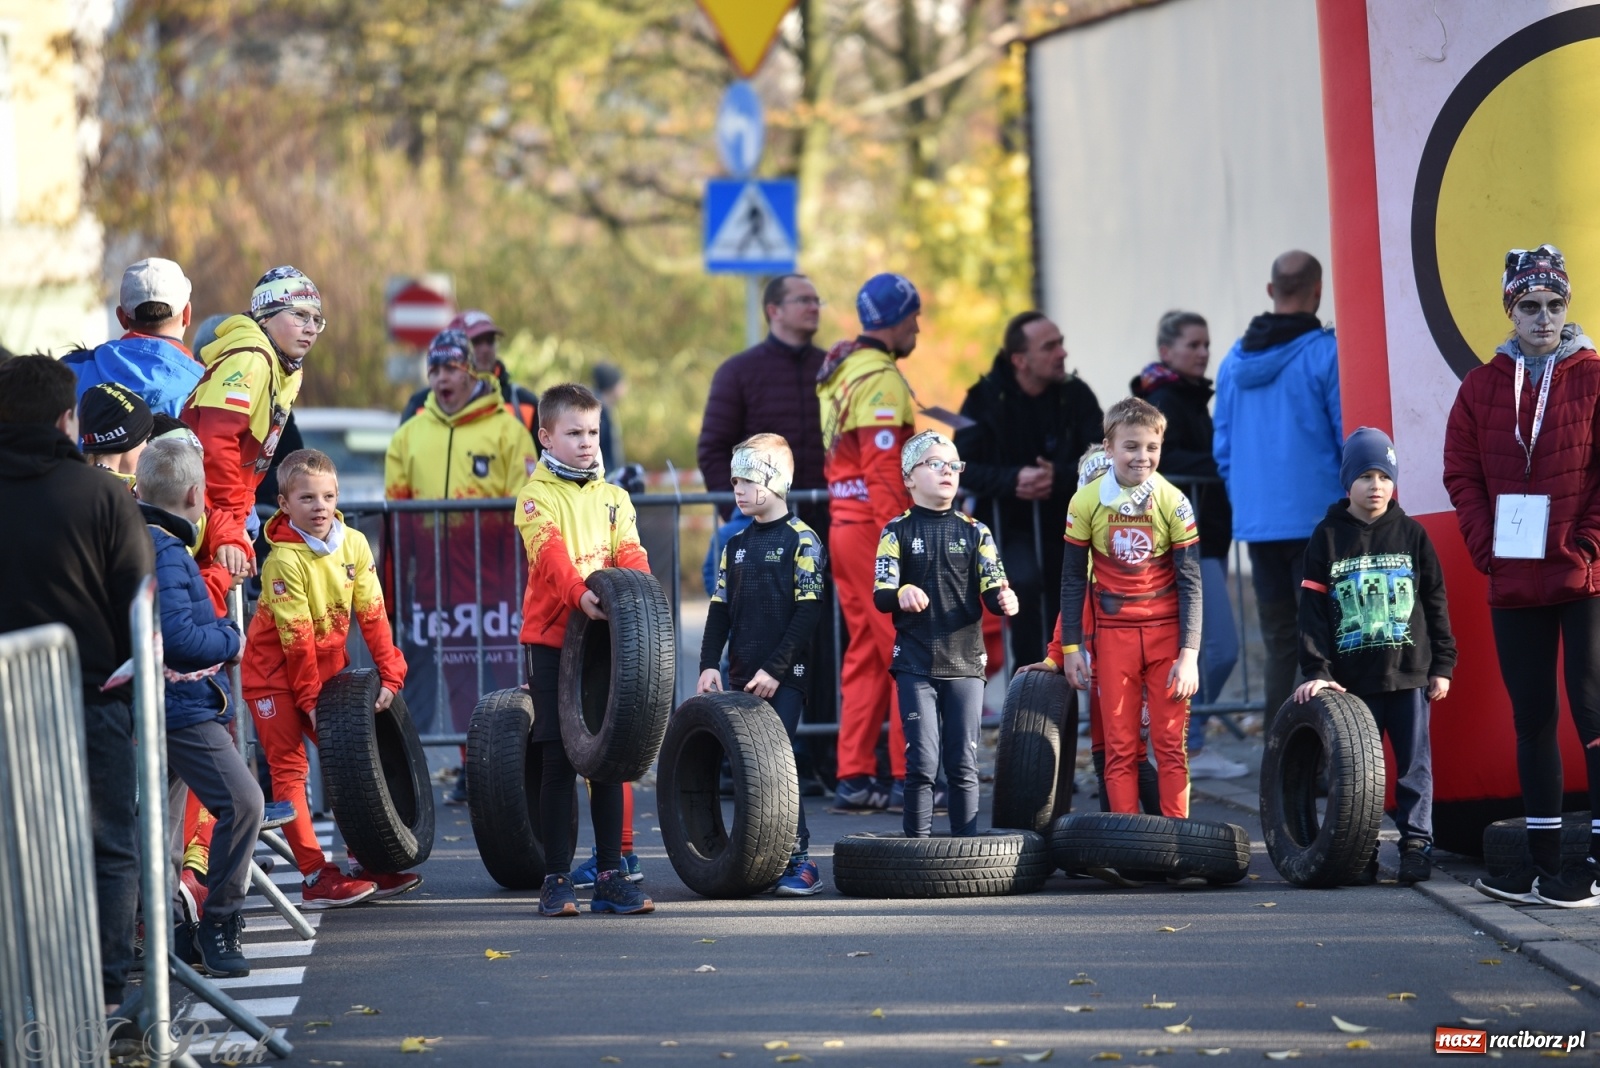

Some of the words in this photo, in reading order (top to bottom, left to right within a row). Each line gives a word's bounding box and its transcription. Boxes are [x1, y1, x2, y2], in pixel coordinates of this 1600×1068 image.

[756, 489, 767, 505] B
[1123, 505, 1131, 514] B
[1511, 508, 1523, 535] 4
[1330, 554, 1413, 578] MINECRAFT
